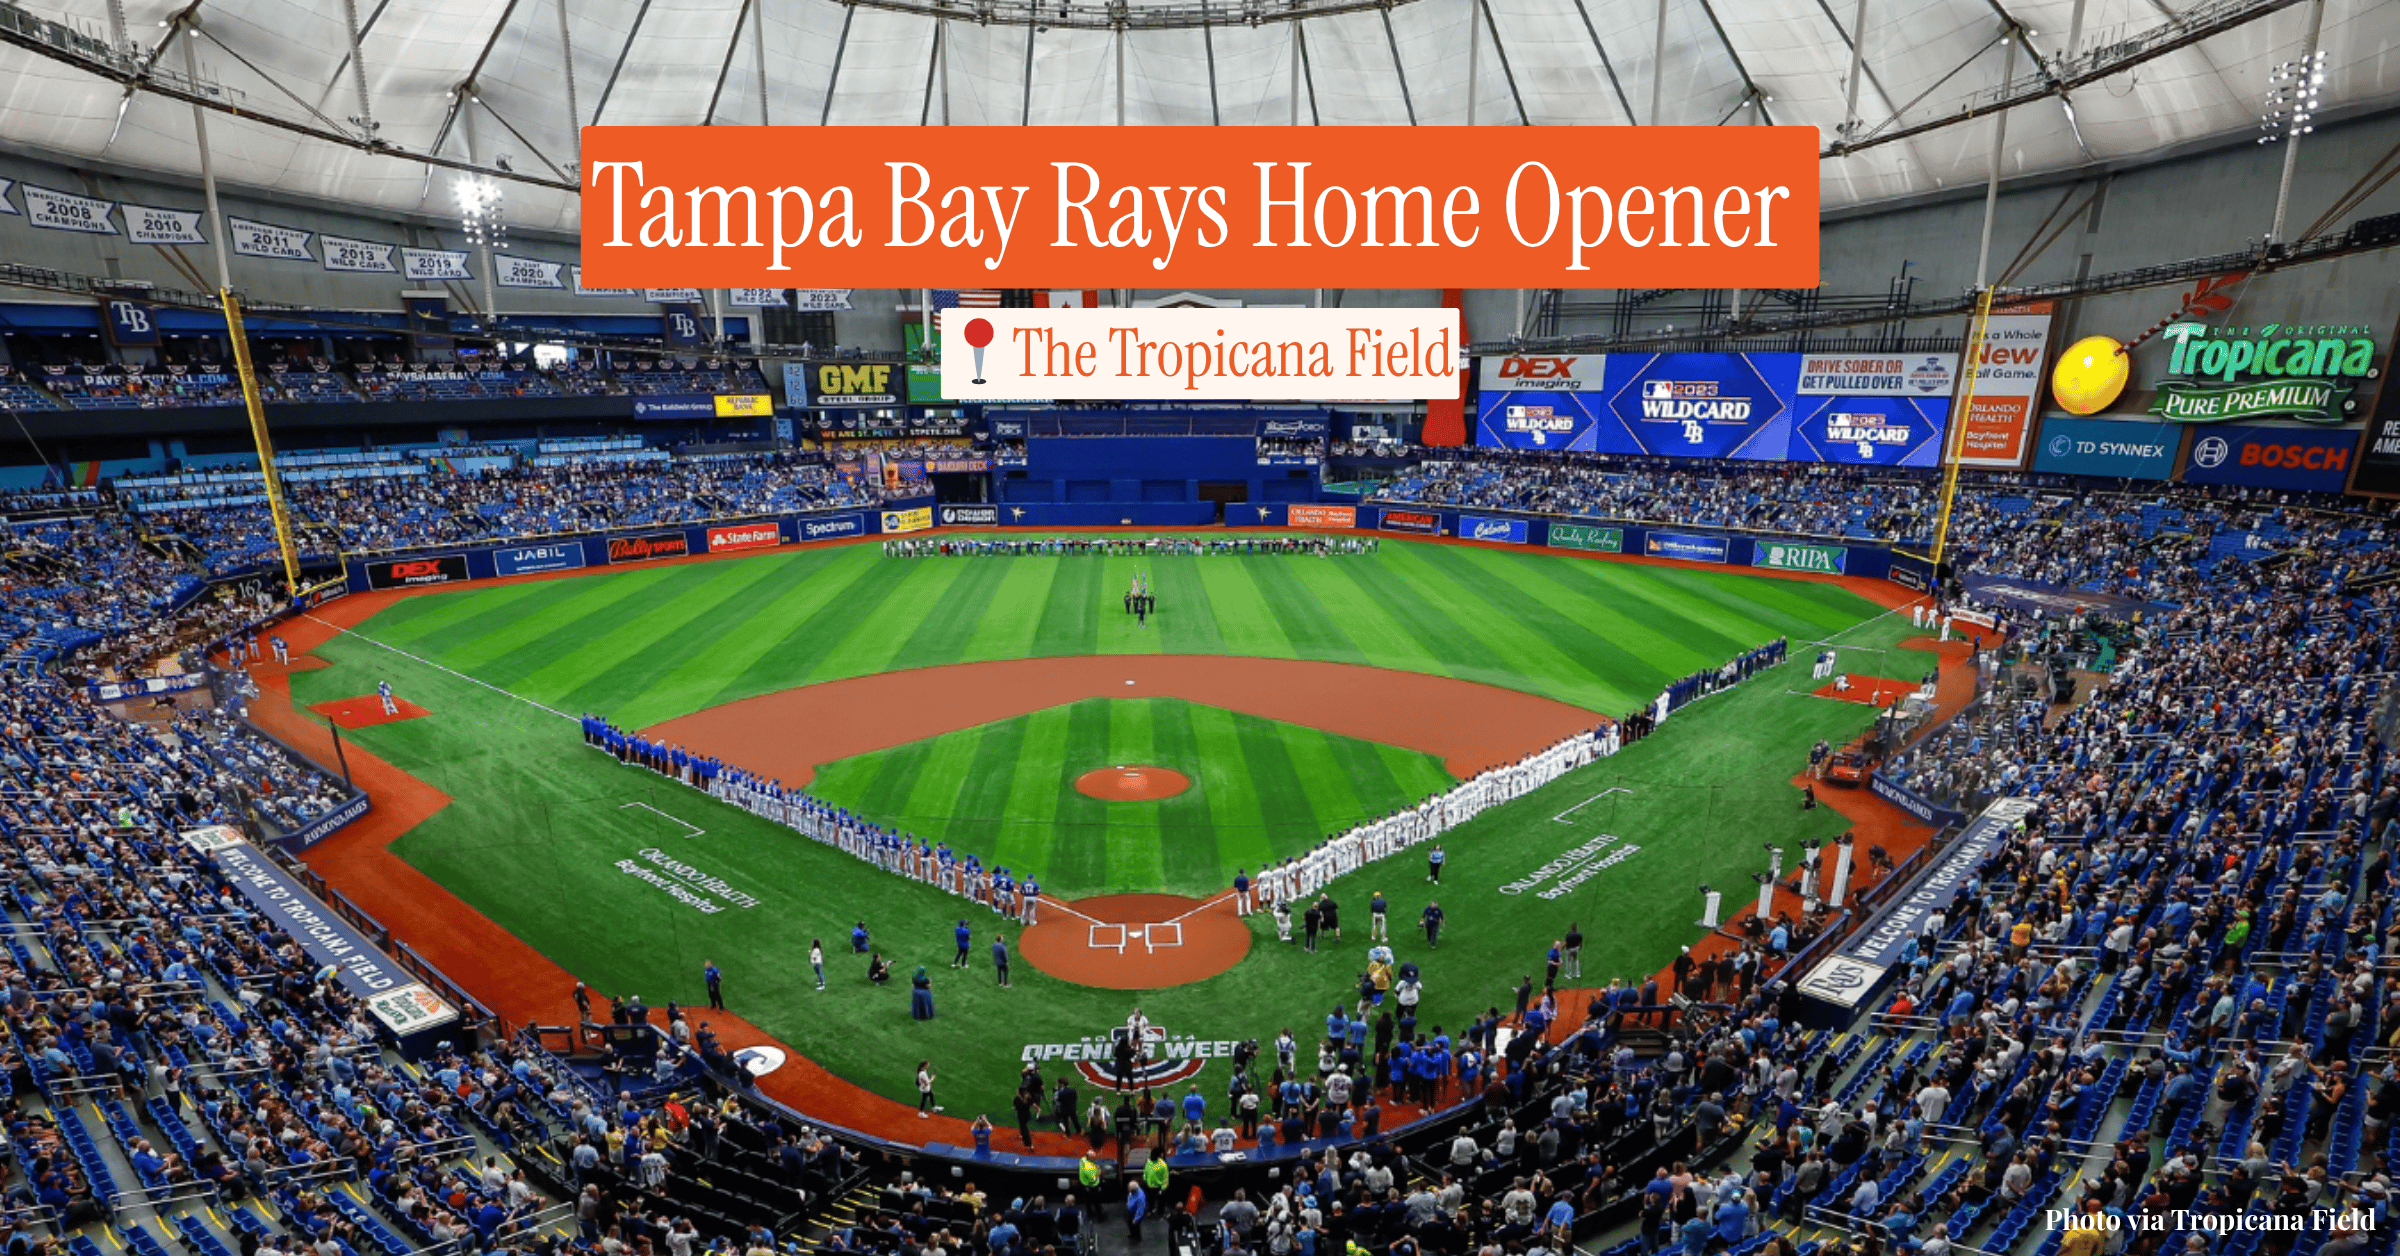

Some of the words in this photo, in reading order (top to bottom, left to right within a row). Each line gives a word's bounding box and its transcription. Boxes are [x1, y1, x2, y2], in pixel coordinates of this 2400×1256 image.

[46, 201, 91, 219] 2008
[36, 213, 106, 230] CHAMPIONS
[143, 219, 181, 232] 2010
[136, 231, 193, 241] CHAMPIONS
[252, 233, 290, 248] 2011
[241, 242, 269, 252] WILD
[272, 246, 302, 257] CARD
[339, 248, 374, 261] 2013
[331, 258, 356, 267] WILD
[359, 260, 386, 269] CARD
[418, 257, 451, 269] 2019
[411, 267, 434, 276] WILD
[437, 269, 462, 277] CARD
[512, 266, 544, 278] 2020
[503, 276, 554, 286] CHAMPIONS
[743, 289, 772, 297] 2022
[810, 293, 838, 302] 2023
[111, 300, 151, 332] TB
[669, 313, 695, 338] TB
[2213, 326, 2250, 336] THE
[2285, 325, 2371, 335] ORIGINAL
[2004, 331, 2042, 340] Whole
[1969, 344, 2039, 365] New
[2163, 323, 2375, 382] Tropicana
[1499, 357, 1577, 379] DEX
[1807, 359, 1841, 373] DRIVE
[1844, 359, 1881, 373] SOBER
[1885, 360, 1904, 373] OR
[819, 364, 891, 394] GMF
[1993, 369, 2037, 380] Game.
[1514, 378, 1582, 390] imaging
[1674, 384, 1719, 397] 2023
[1802, 376, 1826, 390] GET
[1828, 376, 1869, 390] PULLED
[1871, 376, 1904, 390] OVER
[2165, 394, 2221, 416] PURE
[2223, 387, 2331, 413] PREMIUM
[1970, 414, 2013, 423] HEALTH
[820, 430, 837, 438] WE
[838, 430, 856, 438] ARE
[1682, 421, 1703, 444] TB
[1967, 432, 2009, 441] Bayfront
[1967, 443, 2007, 452] Hospital
[2076, 441, 2096, 453] TD
[2099, 442, 2165, 458] SYNNEX
[2239, 443, 2348, 471] BOSCH
[806, 520, 855, 535] Spectrum
[727, 532, 751, 544] State
[753, 529, 777, 542] Farm
[514, 547, 565, 562] JABIL
[1786, 548, 1831, 571] RIPA
[391, 560, 441, 579] DEX
[405, 574, 448, 584] imaging
[639, 848, 707, 881] ORLANDO
[614, 859, 672, 891] Bayfront
[1853, 903, 1923, 959] WELCOME
[1908, 890, 1938, 908] TO
[1932, 842, 1988, 892] TROPICANA
[220, 848, 278, 890] WELCOME
[264, 886, 291, 900] TO
[280, 899, 355, 957] TROPICANA
[342, 954, 394, 990] FIELD
